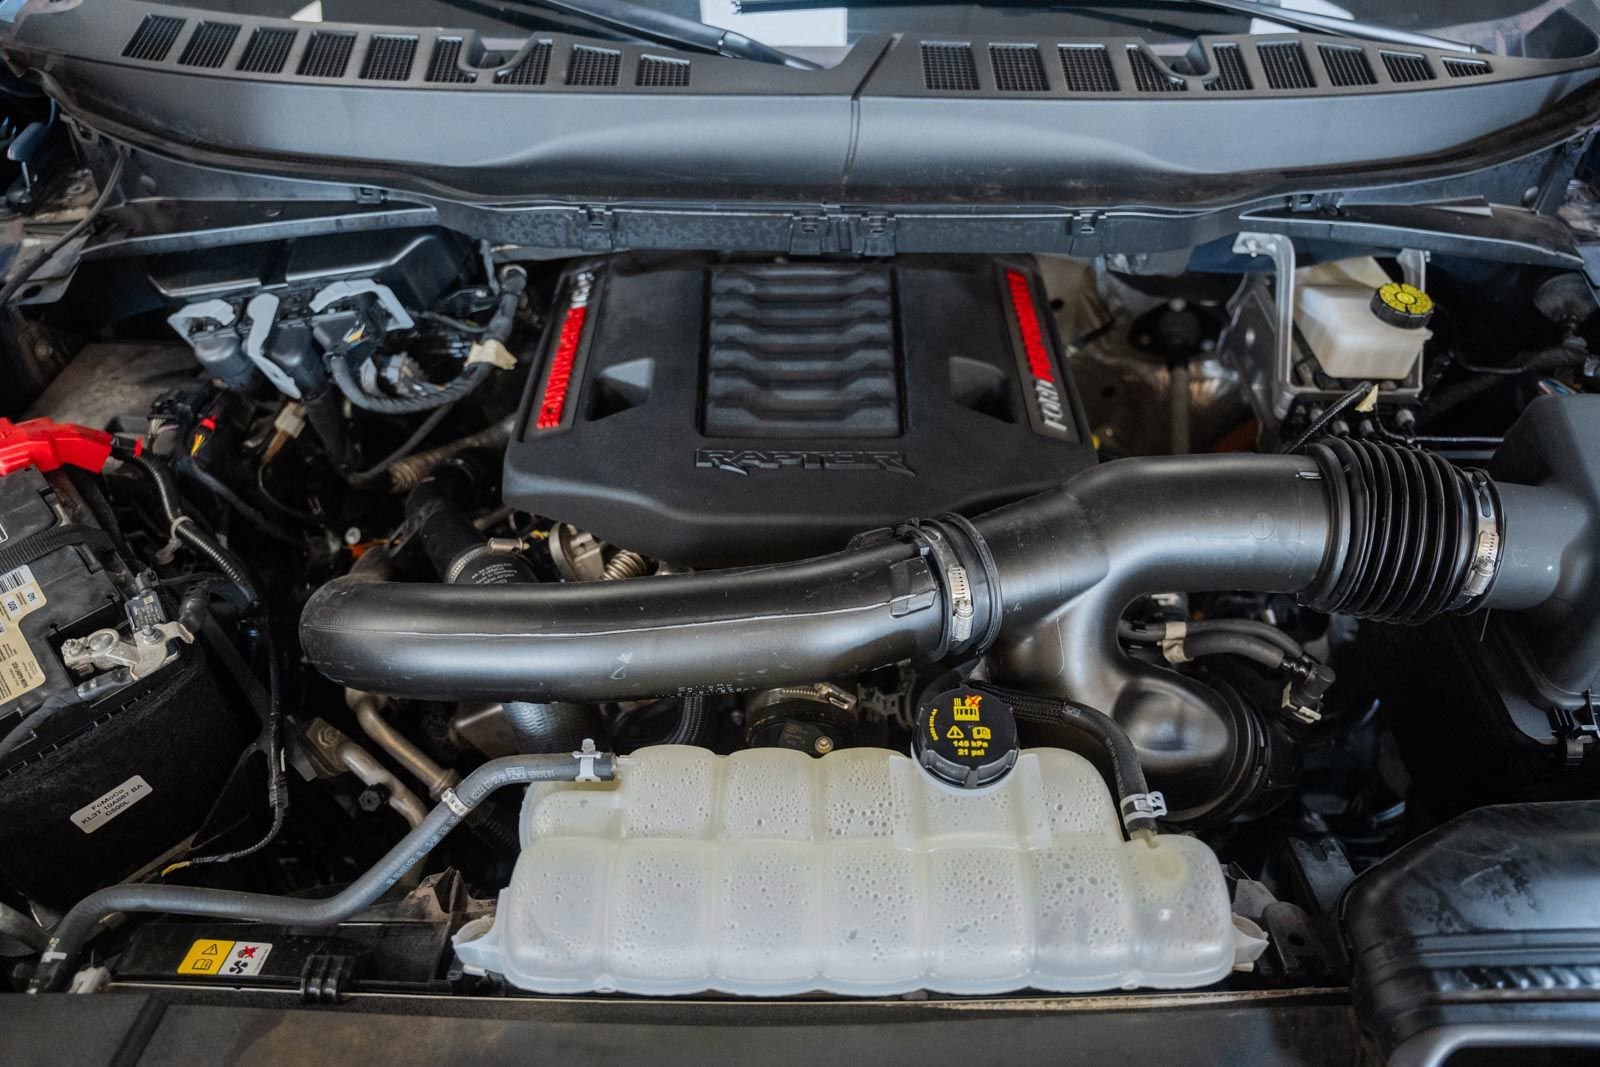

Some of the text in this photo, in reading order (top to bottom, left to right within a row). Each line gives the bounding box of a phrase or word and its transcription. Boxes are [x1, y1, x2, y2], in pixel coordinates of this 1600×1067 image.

[1035, 379, 1068, 432] FORD
[695, 449, 916, 477] RAPTOR
[952, 740, 989, 748] 145 kPa
[957, 748, 986, 757] 21 psi
[81, 809, 102, 824] KL3T
[130, 783, 144, 793] BA
[91, 788, 125, 811] FoMoCo
[105, 800, 130, 817] C500L
